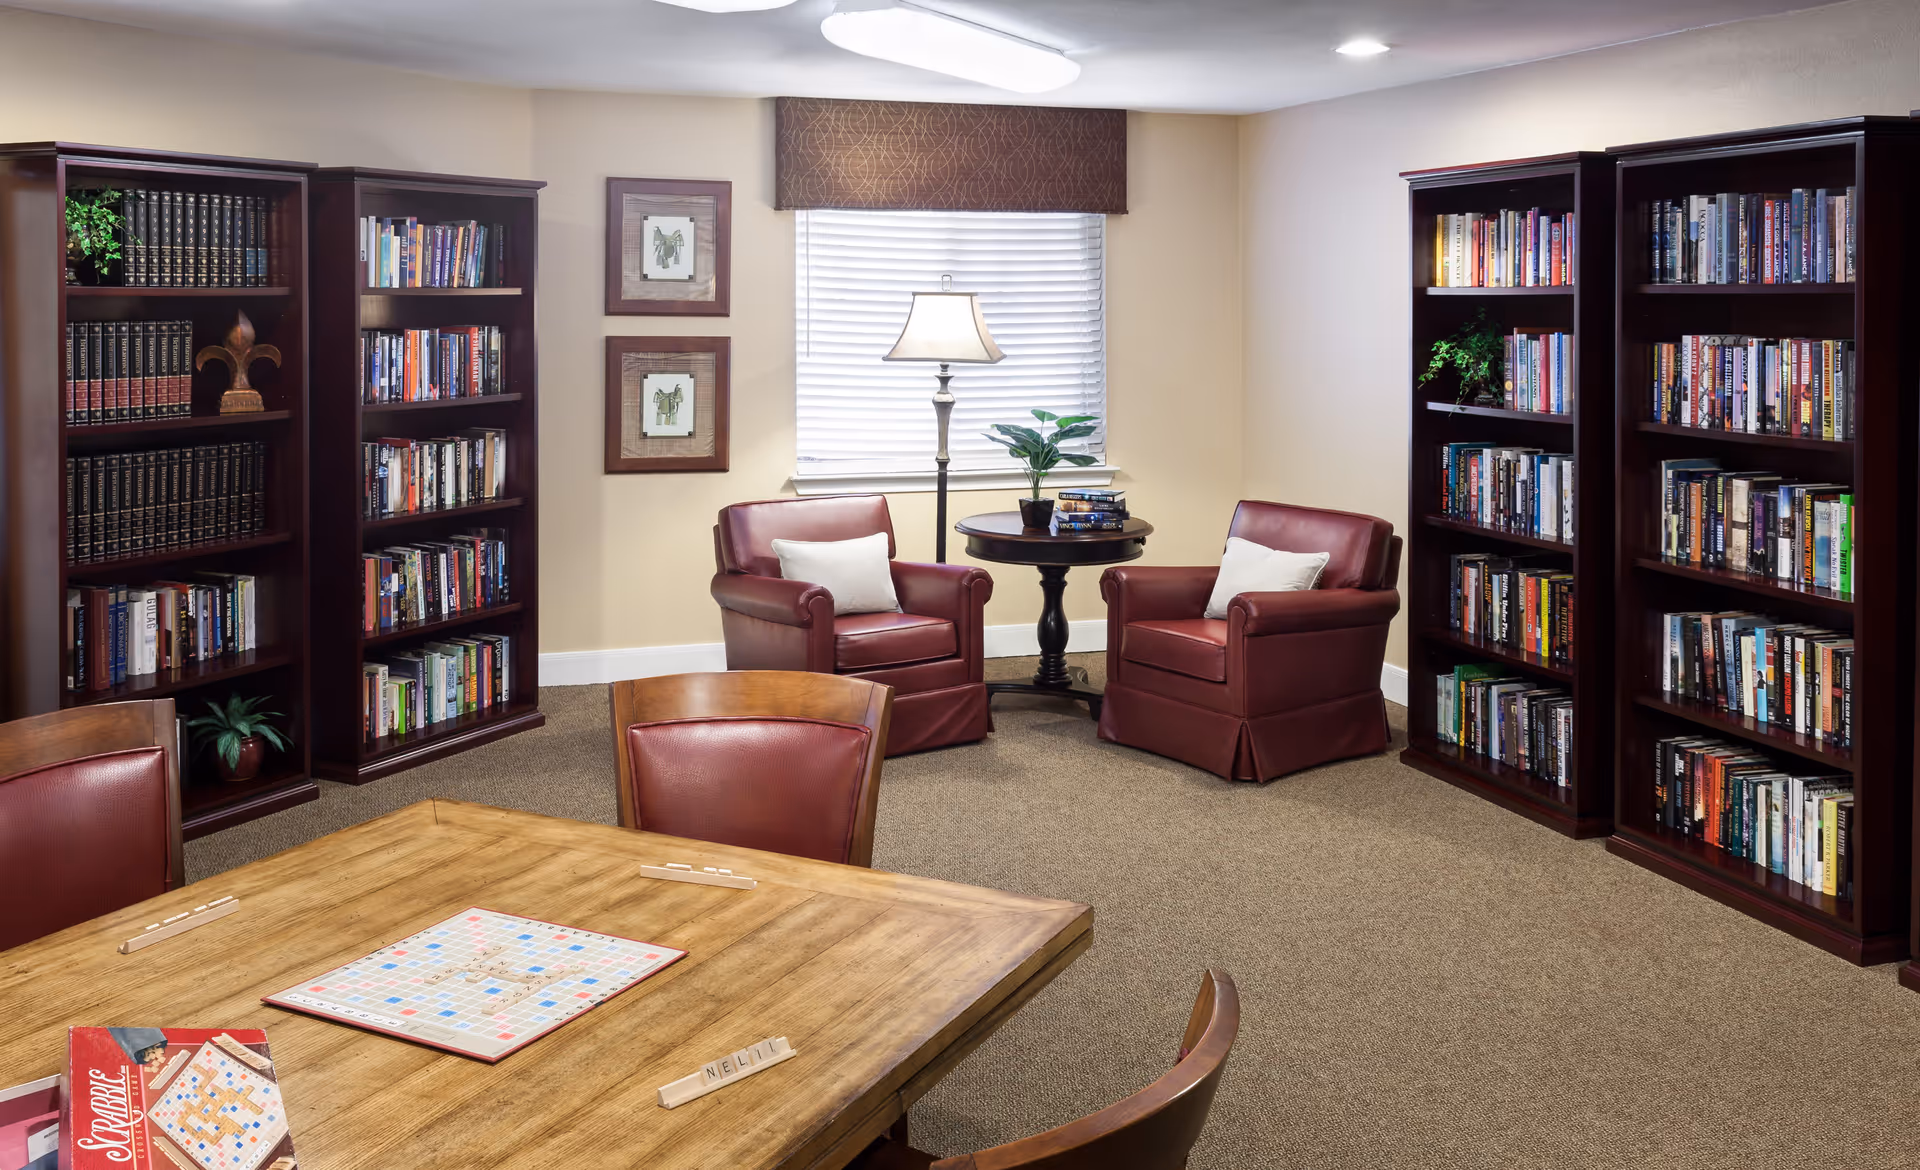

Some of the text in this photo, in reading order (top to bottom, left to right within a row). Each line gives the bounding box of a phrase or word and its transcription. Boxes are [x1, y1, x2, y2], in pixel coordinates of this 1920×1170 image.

[1824, 400, 1832, 429] THERAPY
[146, 598, 156, 630] GULAG
[1838, 809, 1846, 828] STEVE
[130, 1074, 139, 1096] GAME
[78, 1067, 144, 1162] SCRABBLE
